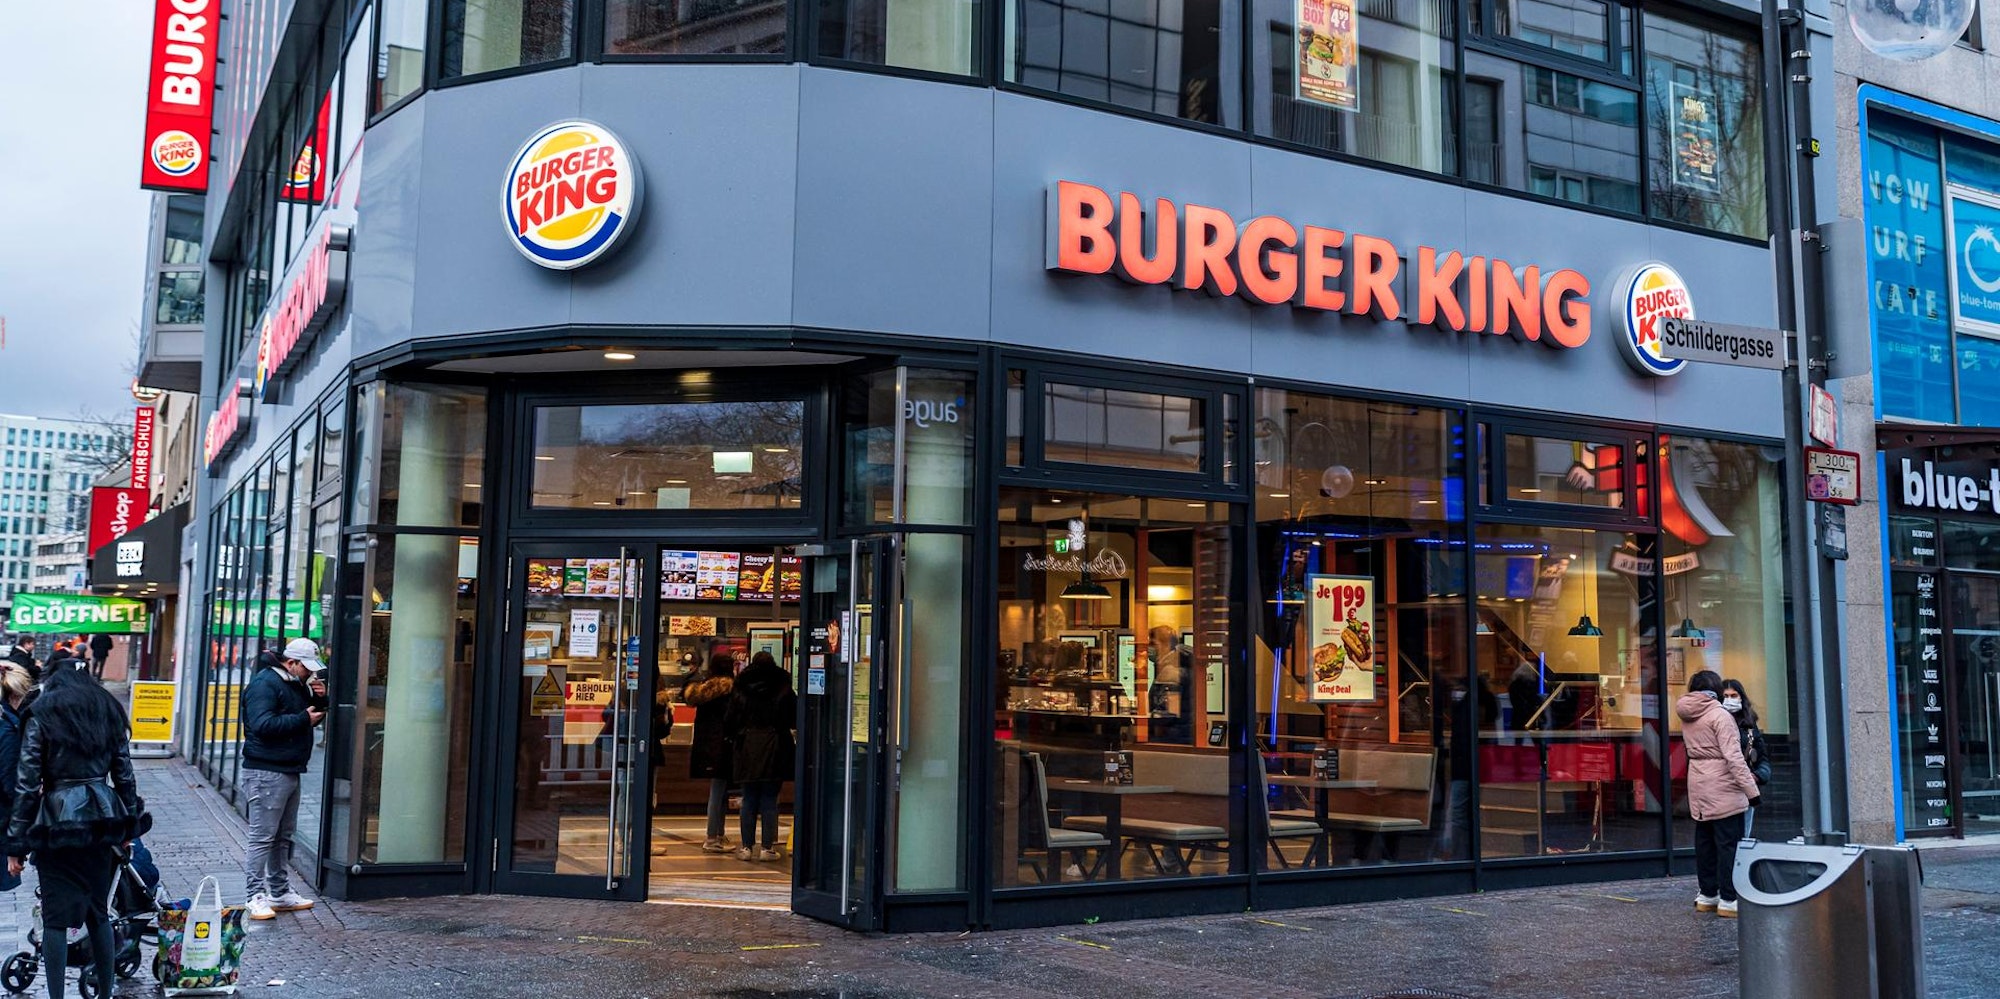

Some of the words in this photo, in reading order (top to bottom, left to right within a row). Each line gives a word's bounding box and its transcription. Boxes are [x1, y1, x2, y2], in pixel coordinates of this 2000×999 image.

[1303, 6, 1324, 25] BOX
[159, 148, 195, 163] KING
[516, 145, 616, 200] BURGER
[519, 168, 618, 236] KING
[1056, 180, 1401, 321] BURGER
[1417, 245, 1592, 349] KING
[1636, 288, 1687, 317] BURGER
[1665, 321, 1774, 361] Schildergasse
[134, 408, 152, 489] FAHRSCHULE
[1809, 453, 1817, 464] H
[1825, 454, 1845, 468] 300
[744, 555, 768, 563] Cheesy
[1316, 584, 1330, 599] Je
[15, 600, 147, 625] GEÖFFNET!
[576, 684, 614, 693] ABHOLEN
[576, 692, 595, 701] HIER
[1317, 684, 1335, 695] King
[1335, 684, 1351, 694] Deal
